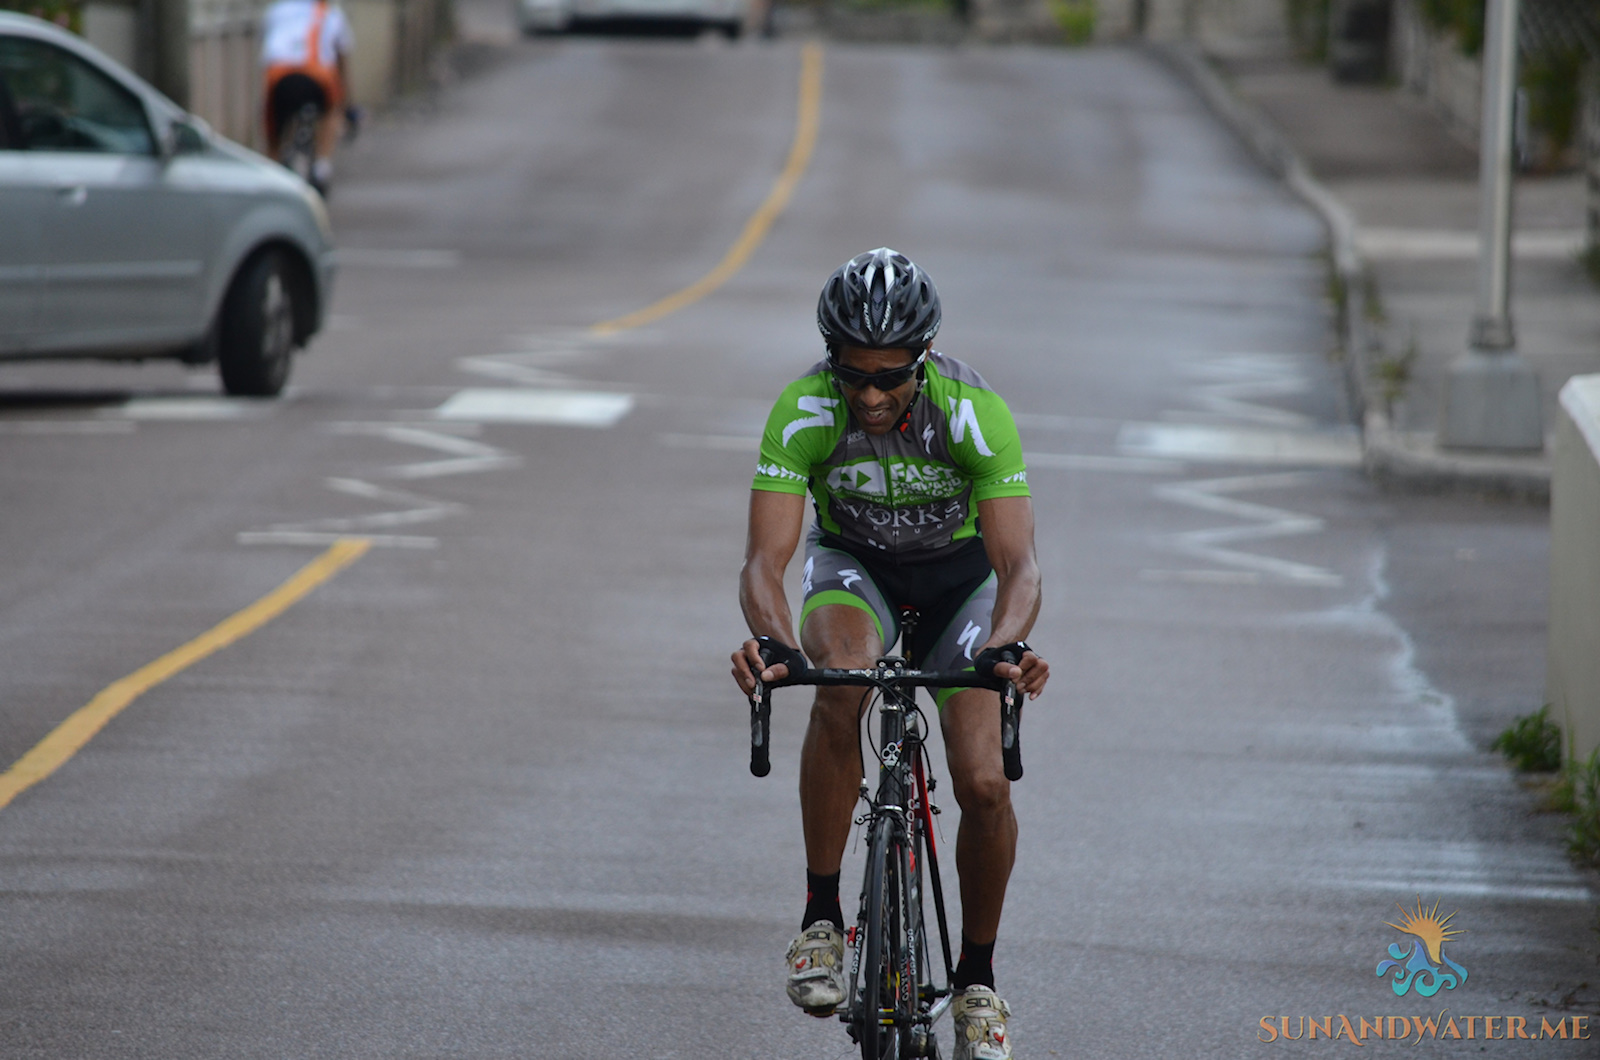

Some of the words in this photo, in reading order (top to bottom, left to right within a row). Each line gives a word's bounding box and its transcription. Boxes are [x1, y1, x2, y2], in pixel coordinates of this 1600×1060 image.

[890, 462, 955, 483] FAST
[806, 930, 831, 941] SIDI
[965, 997, 992, 1009] SIDI
